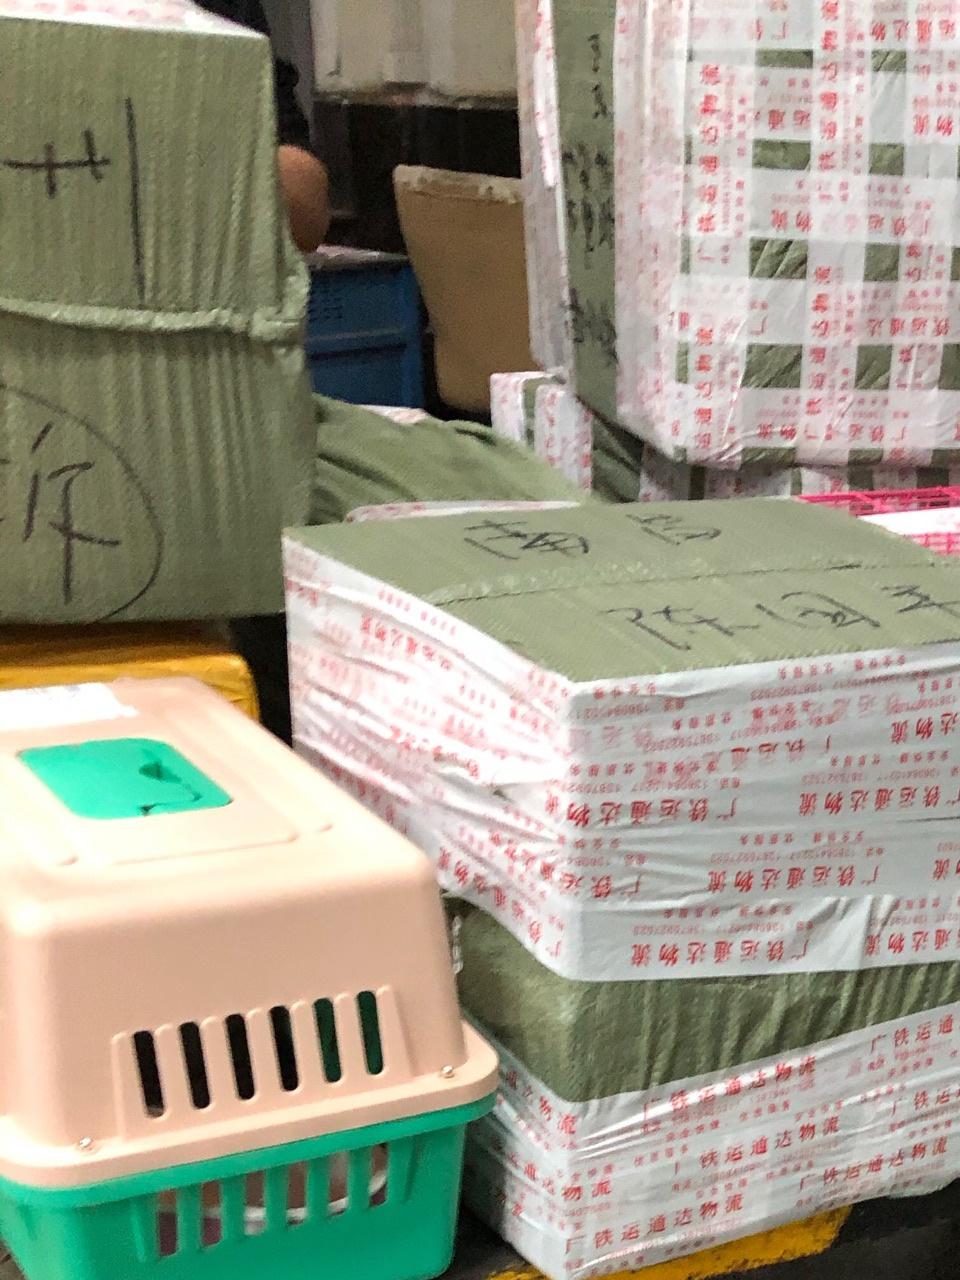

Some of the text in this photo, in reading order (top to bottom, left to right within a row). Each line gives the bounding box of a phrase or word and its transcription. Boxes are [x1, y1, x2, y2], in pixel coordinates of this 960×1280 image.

[707, 865, 880, 894] 广铁运通达物流
[631, 939, 809, 967] 广铁运通达物流
[642, 1055, 816, 1121] 广铁运通达物流
[800, 1135, 948, 1191] 广铁运通达物流
[565, 1193, 743, 1255] 广铁运通达物流
